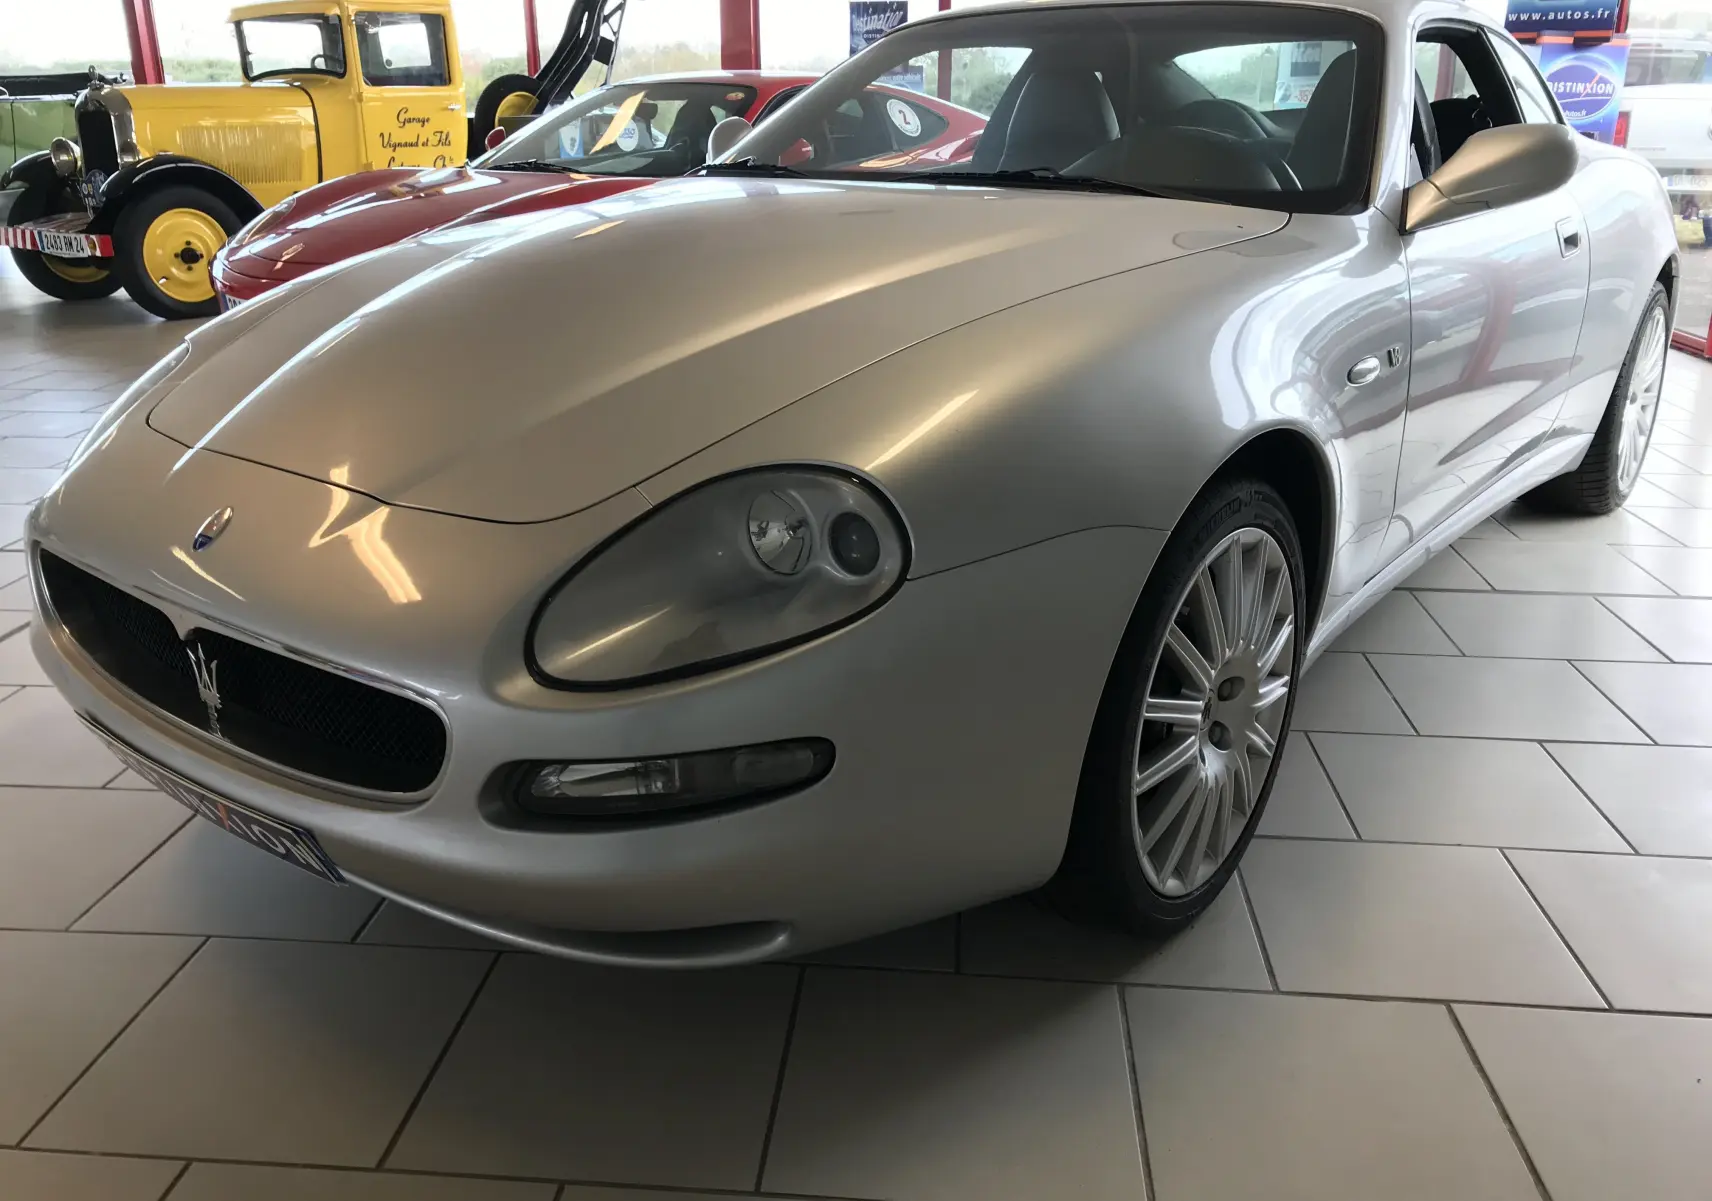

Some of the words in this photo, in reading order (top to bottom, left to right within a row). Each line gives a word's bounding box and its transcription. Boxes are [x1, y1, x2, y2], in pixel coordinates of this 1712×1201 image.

[1508, 8, 1610, 21] www.autos.fr
[397, 107, 430, 128] Garage
[379, 132, 420, 152] Vignaud
[421, 137, 430, 148] et
[431, 131, 451, 147] Fils
[74, 236, 85, 254] 24
